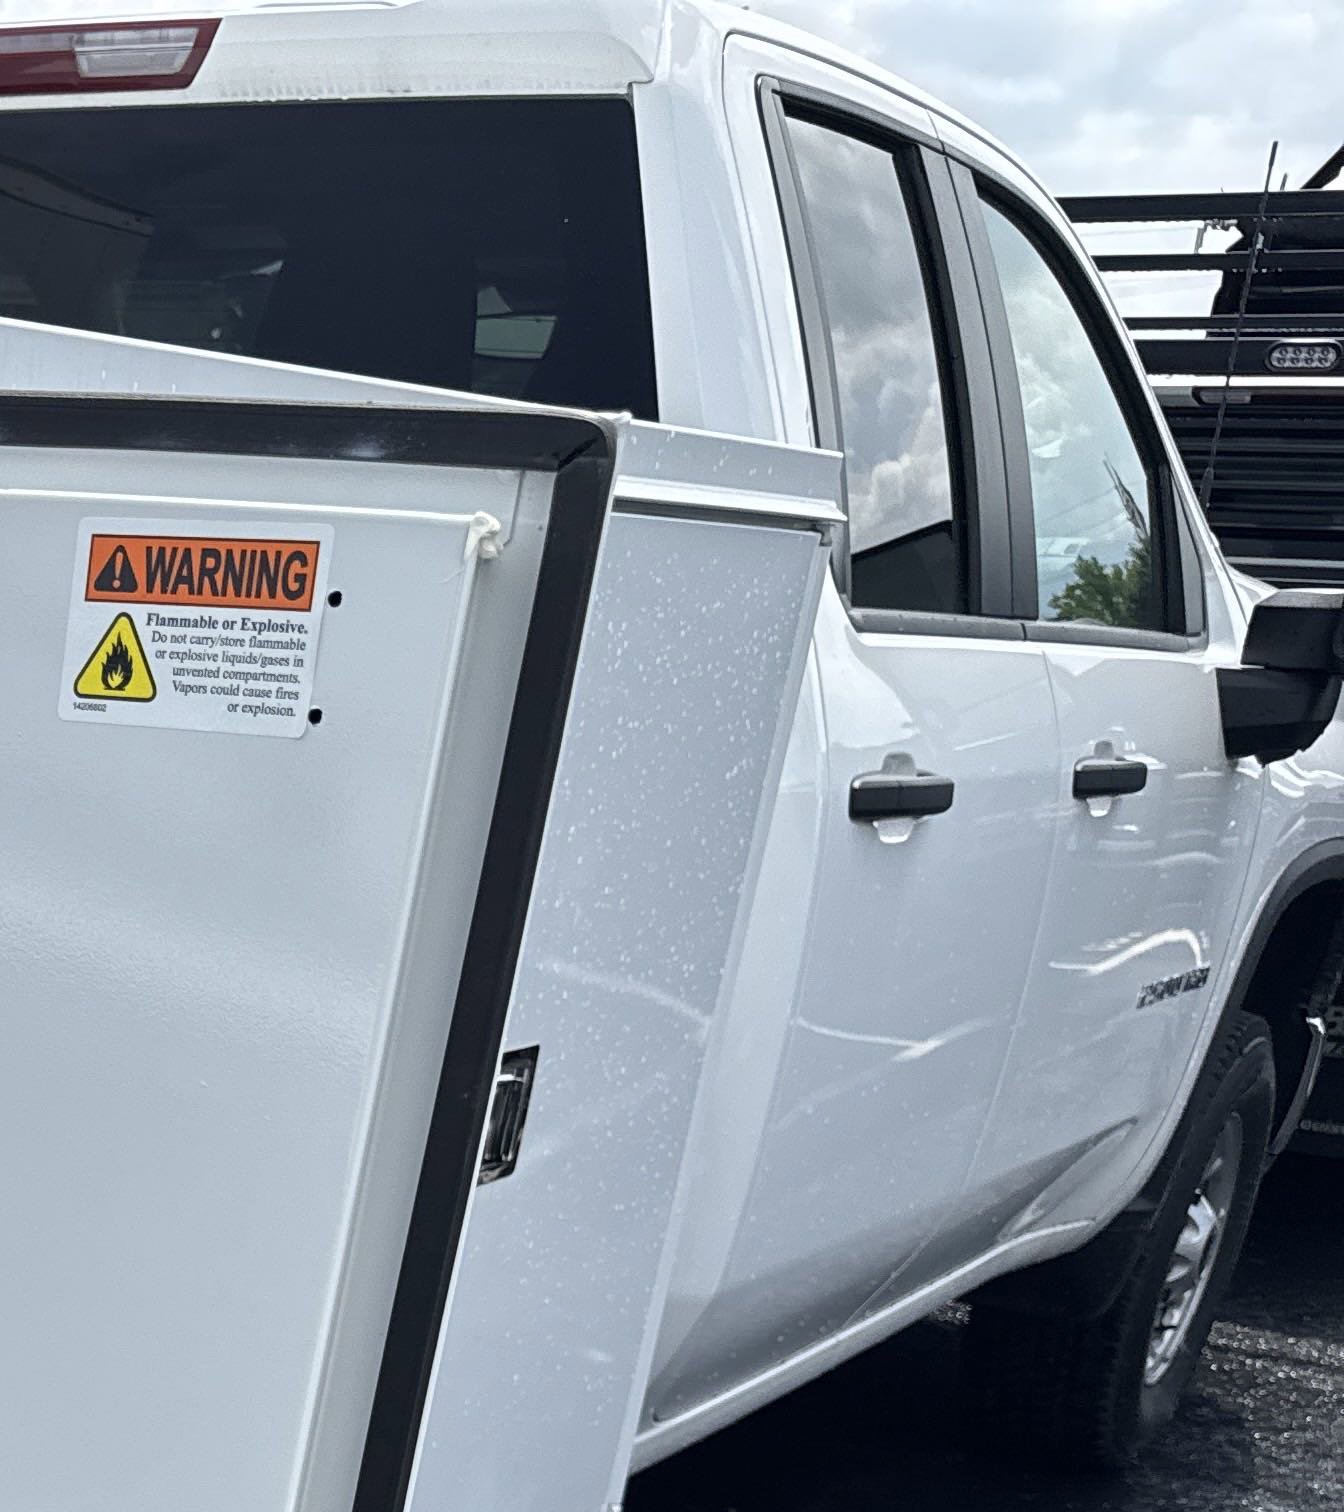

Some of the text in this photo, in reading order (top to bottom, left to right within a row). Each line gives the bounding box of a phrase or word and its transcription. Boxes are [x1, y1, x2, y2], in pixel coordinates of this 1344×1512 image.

[145, 545, 308, 601] WARNING
[146, 612, 308, 635] Flammable or Explosive.
[151, 630, 306, 651] Do not carry/store flammable
[155, 649, 304, 668] or explosive liquids/gases in
[172, 666, 301, 684] unvented compartments.
[172, 680, 300, 700] Vapors could cause fires
[227, 702, 296, 717] or explosion.
